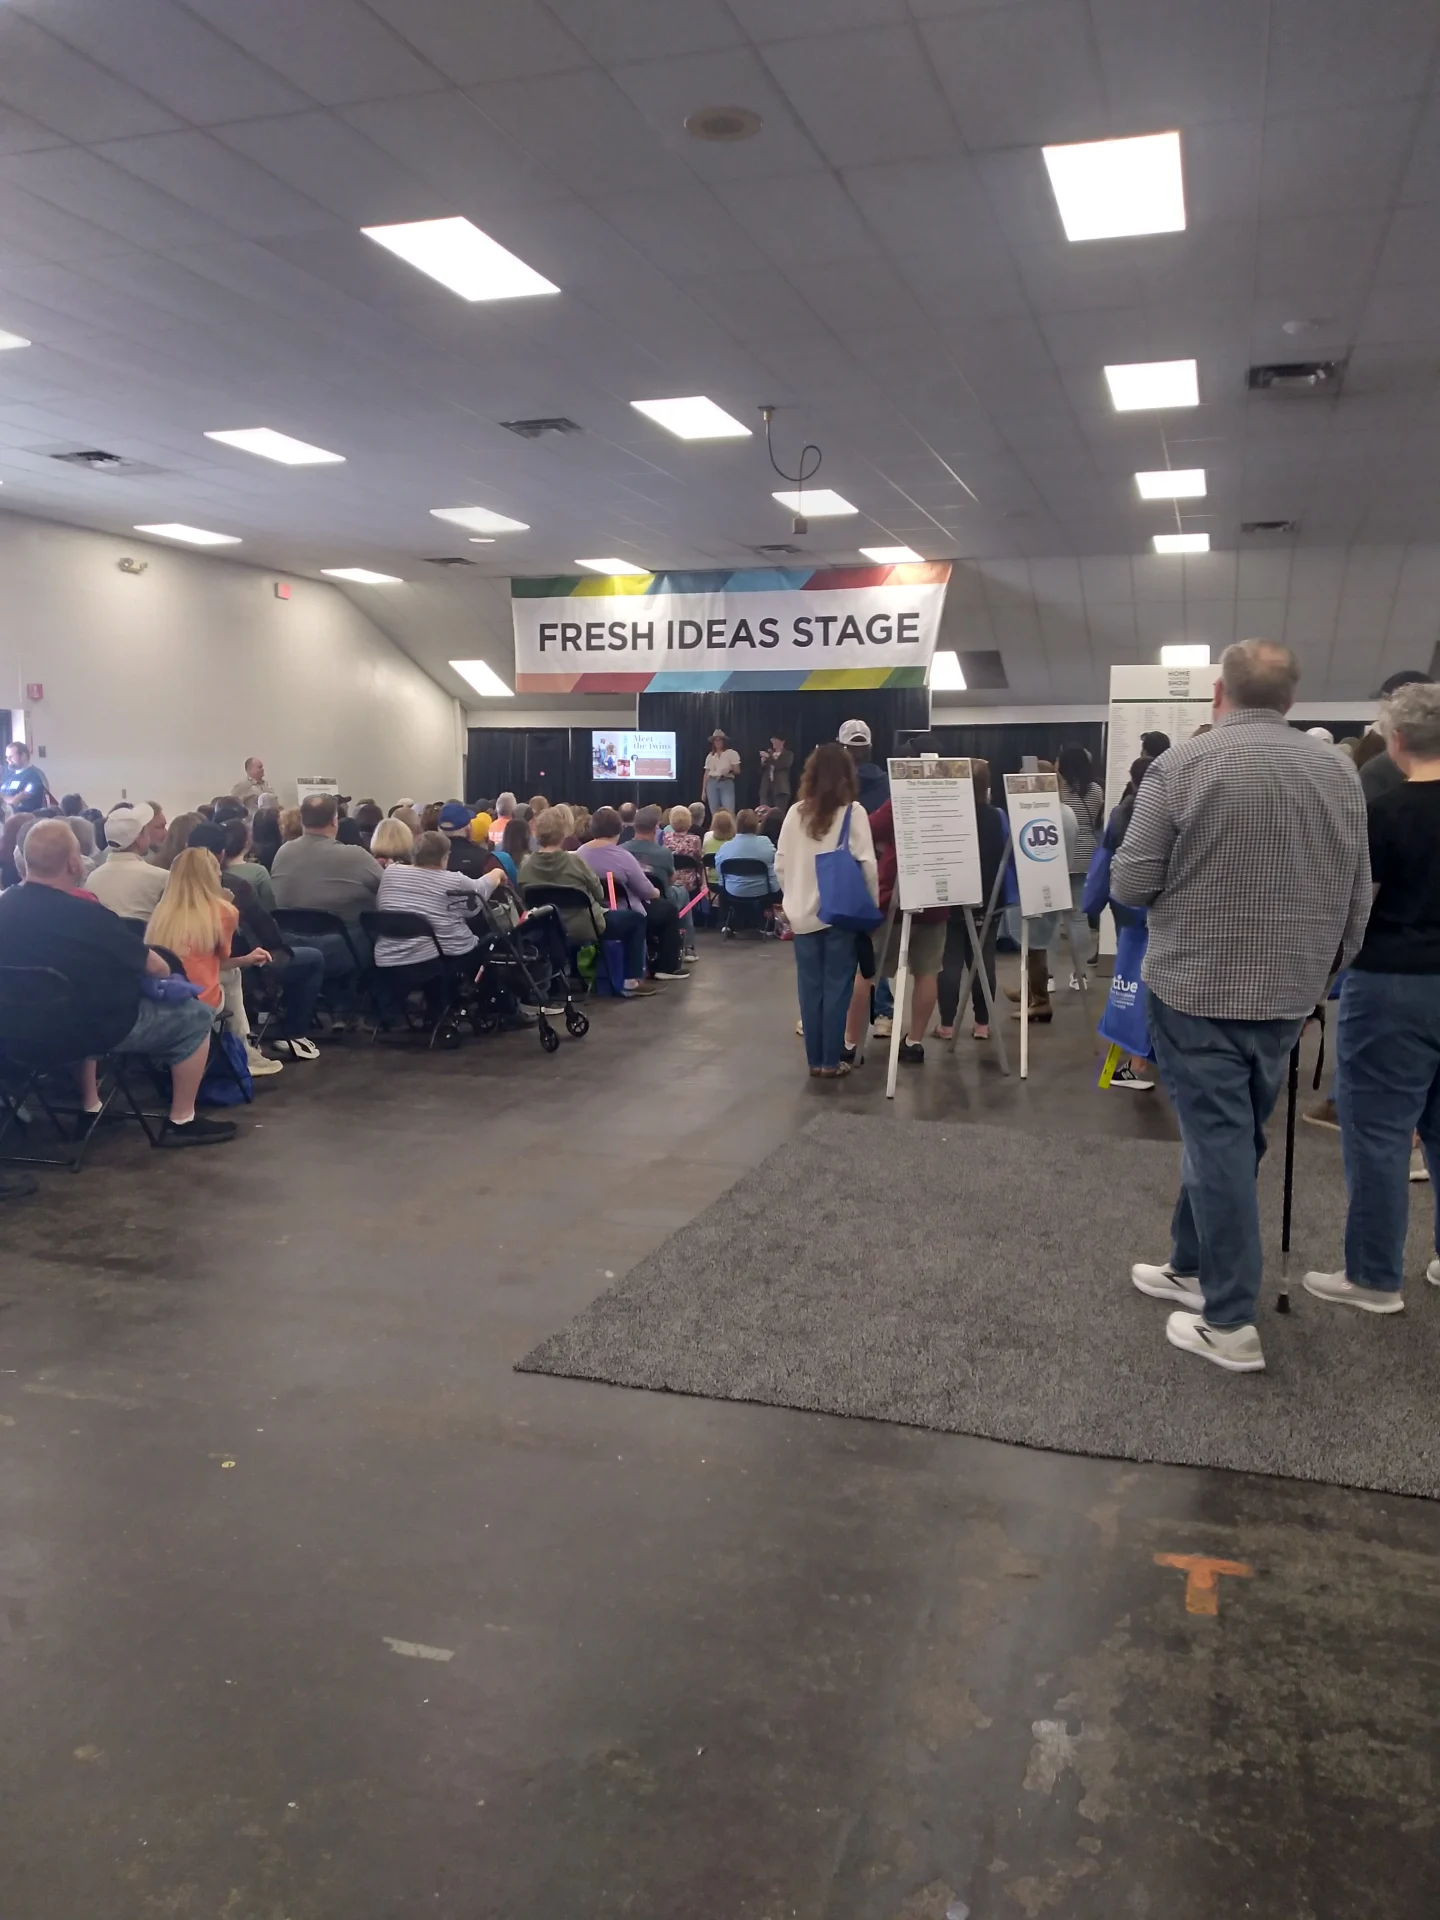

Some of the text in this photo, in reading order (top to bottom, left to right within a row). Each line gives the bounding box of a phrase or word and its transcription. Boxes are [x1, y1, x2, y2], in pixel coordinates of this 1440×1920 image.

[539, 612, 920, 652] FRESH IDEAS STAGE
[633, 734, 653, 742] Meet
[1027, 824, 1059, 847] JDS
